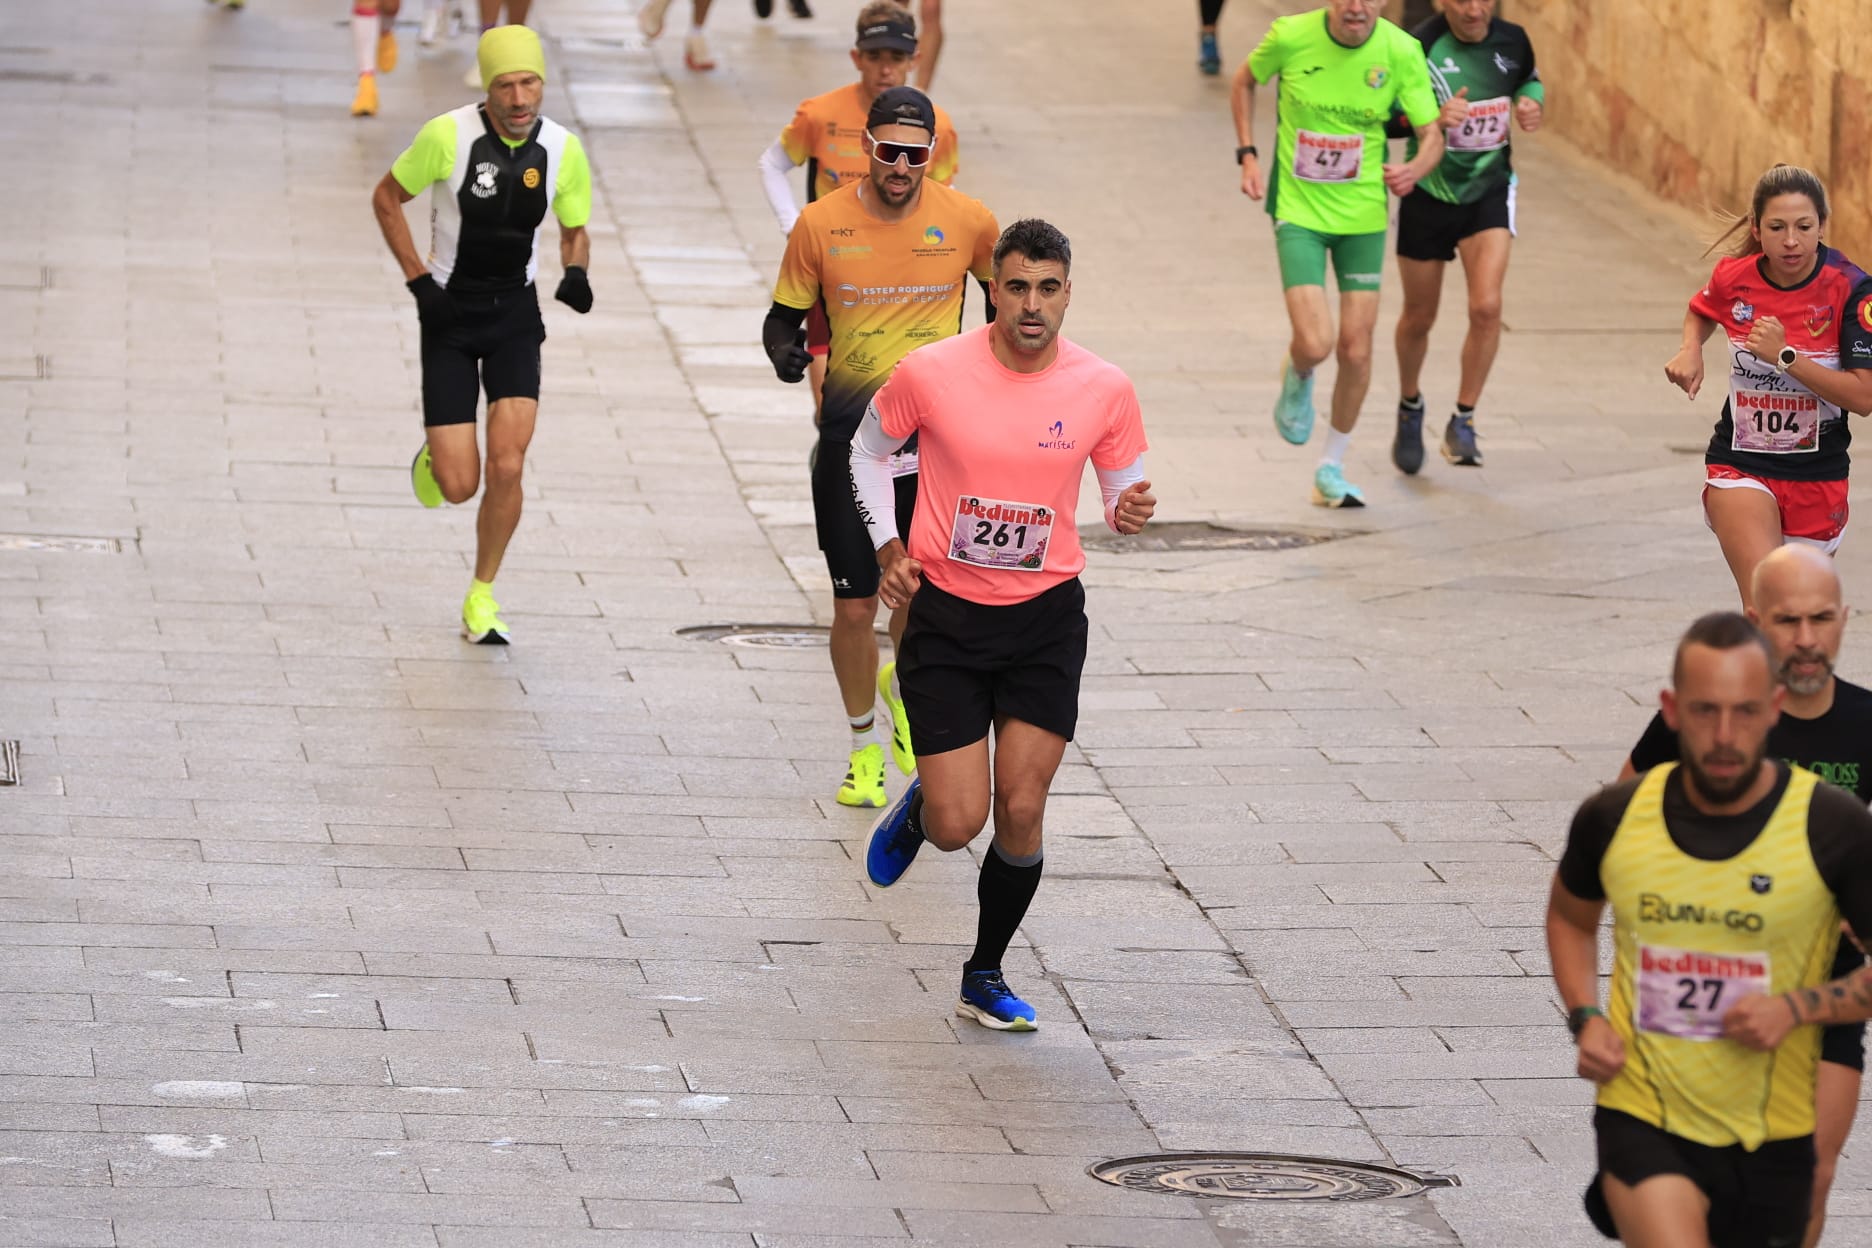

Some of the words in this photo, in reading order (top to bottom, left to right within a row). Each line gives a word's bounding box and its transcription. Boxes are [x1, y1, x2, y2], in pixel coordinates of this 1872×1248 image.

[1463, 116, 1498, 137] 672
[1315, 150, 1342, 167] 47
[862, 287, 895, 295] ESTER
[1736, 391, 1818, 411] bedunia
[1753, 410, 1800, 433] 104
[1038, 440, 1076, 450] maristas
[959, 498, 1052, 526] bedunia
[973, 521, 1027, 549] 261
[1809, 761, 1859, 784] CROSS
[1640, 946, 1766, 977] bedunia
[1677, 977, 1725, 1011] 27
